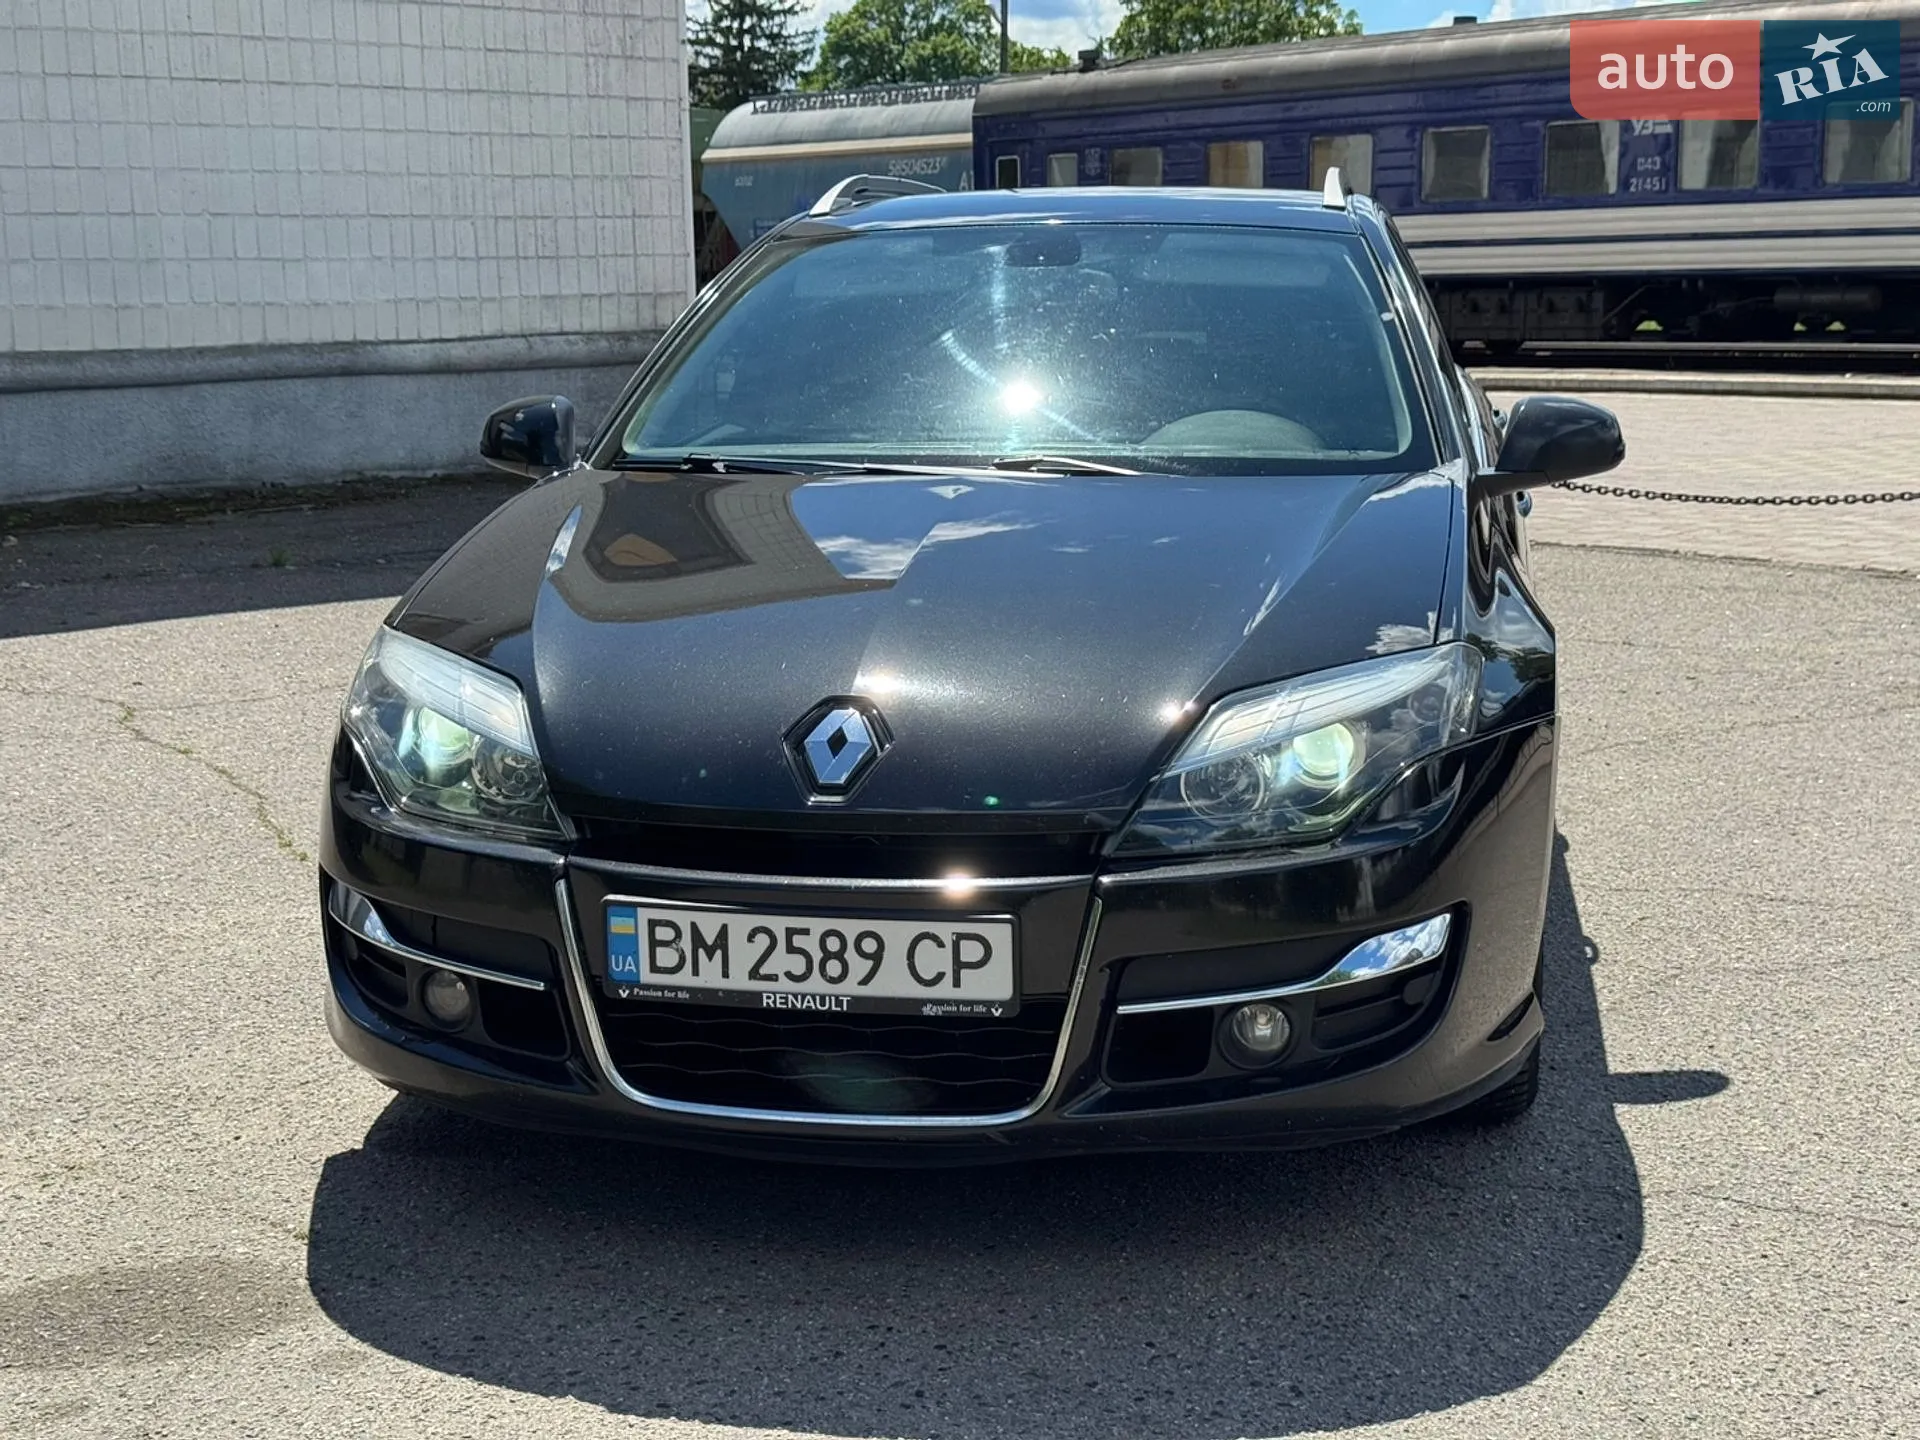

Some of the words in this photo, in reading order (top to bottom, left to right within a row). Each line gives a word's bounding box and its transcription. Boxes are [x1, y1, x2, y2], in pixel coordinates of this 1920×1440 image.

[1629, 176, 1667, 192] 21451
[647, 918, 730, 979] BM
[747, 925, 886, 987] 2589
[906, 931, 993, 988] CP
[611, 955, 637, 973] UA
[633, 987, 662, 998] Passion
[663, 989, 676, 999] for
[677, 990, 690, 999] life
[762, 992, 852, 1012] RENAULT
[959, 1004, 972, 1012] for
[973, 1004, 987, 1013] life
